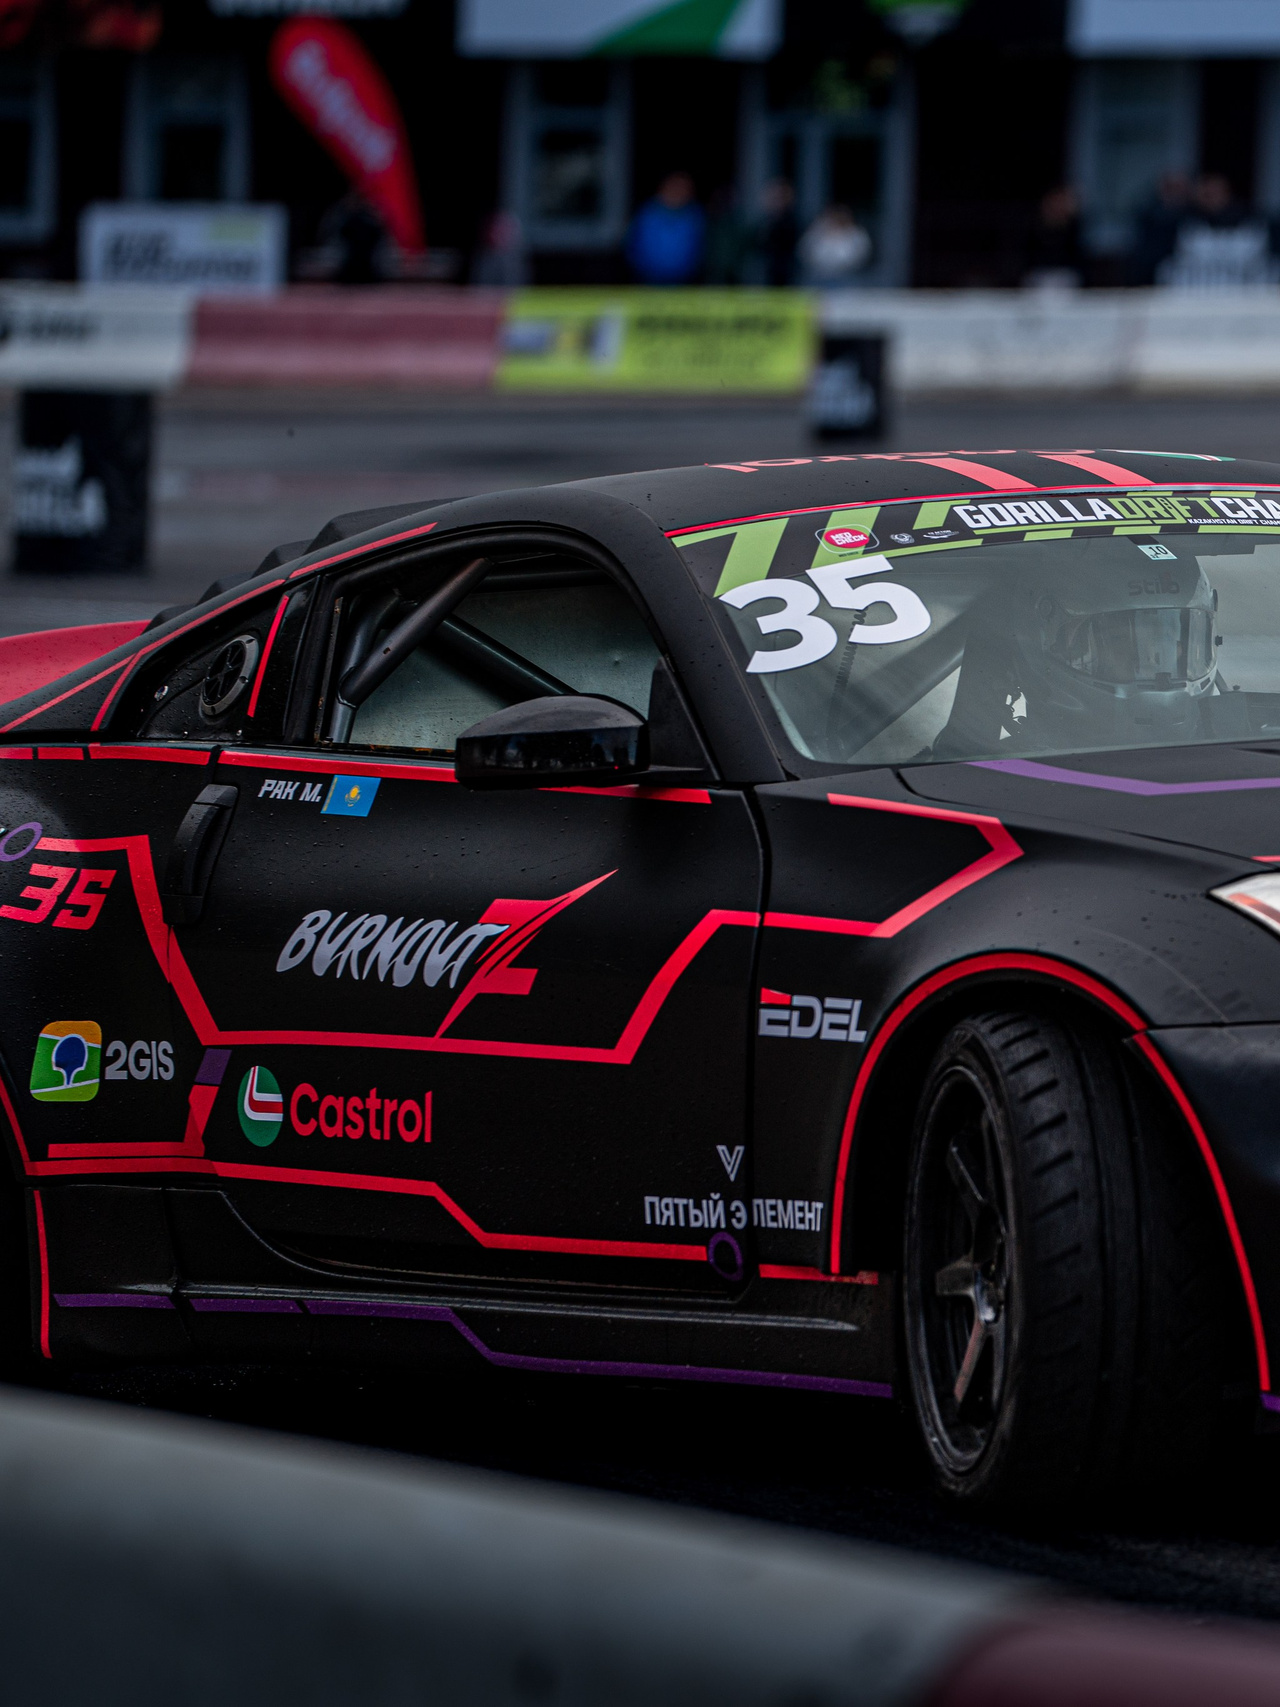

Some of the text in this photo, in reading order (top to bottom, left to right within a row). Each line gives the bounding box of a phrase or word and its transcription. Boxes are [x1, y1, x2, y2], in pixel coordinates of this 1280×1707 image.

[831, 531, 853, 541] MED
[834, 534, 868, 546] CHECK
[1149, 546, 1168, 555] 10
[718, 554, 932, 674] 35
[257, 779, 301, 800] PAK
[0, 862, 118, 931] 35
[758, 987, 868, 1043] EDEL
[104, 1040, 175, 1082] 2GIS
[290, 1082, 433, 1144] Castrol
[643, 1192, 727, 1229] ПЯТЫЙ
